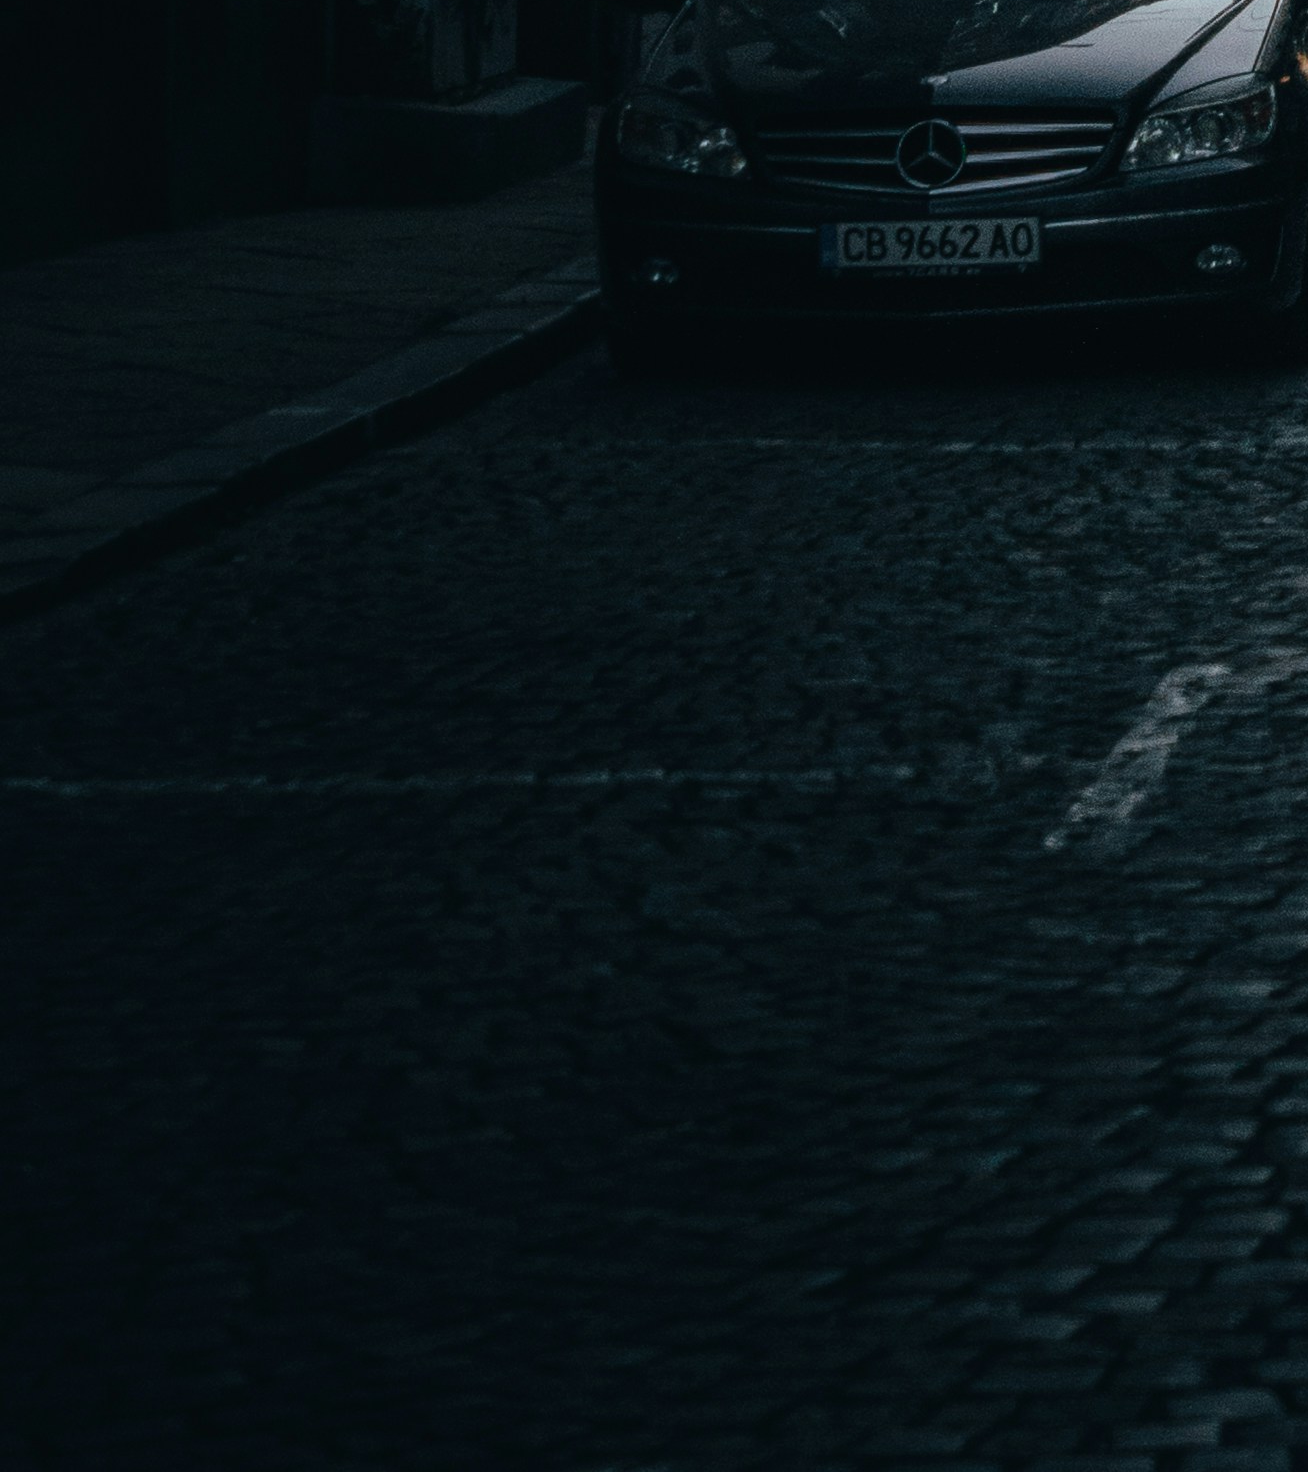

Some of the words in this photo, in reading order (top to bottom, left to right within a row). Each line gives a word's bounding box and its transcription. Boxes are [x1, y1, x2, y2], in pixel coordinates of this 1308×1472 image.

[843, 227, 887, 261] CB
[897, 225, 980, 260] 9662
[989, 223, 1034, 258] AO
